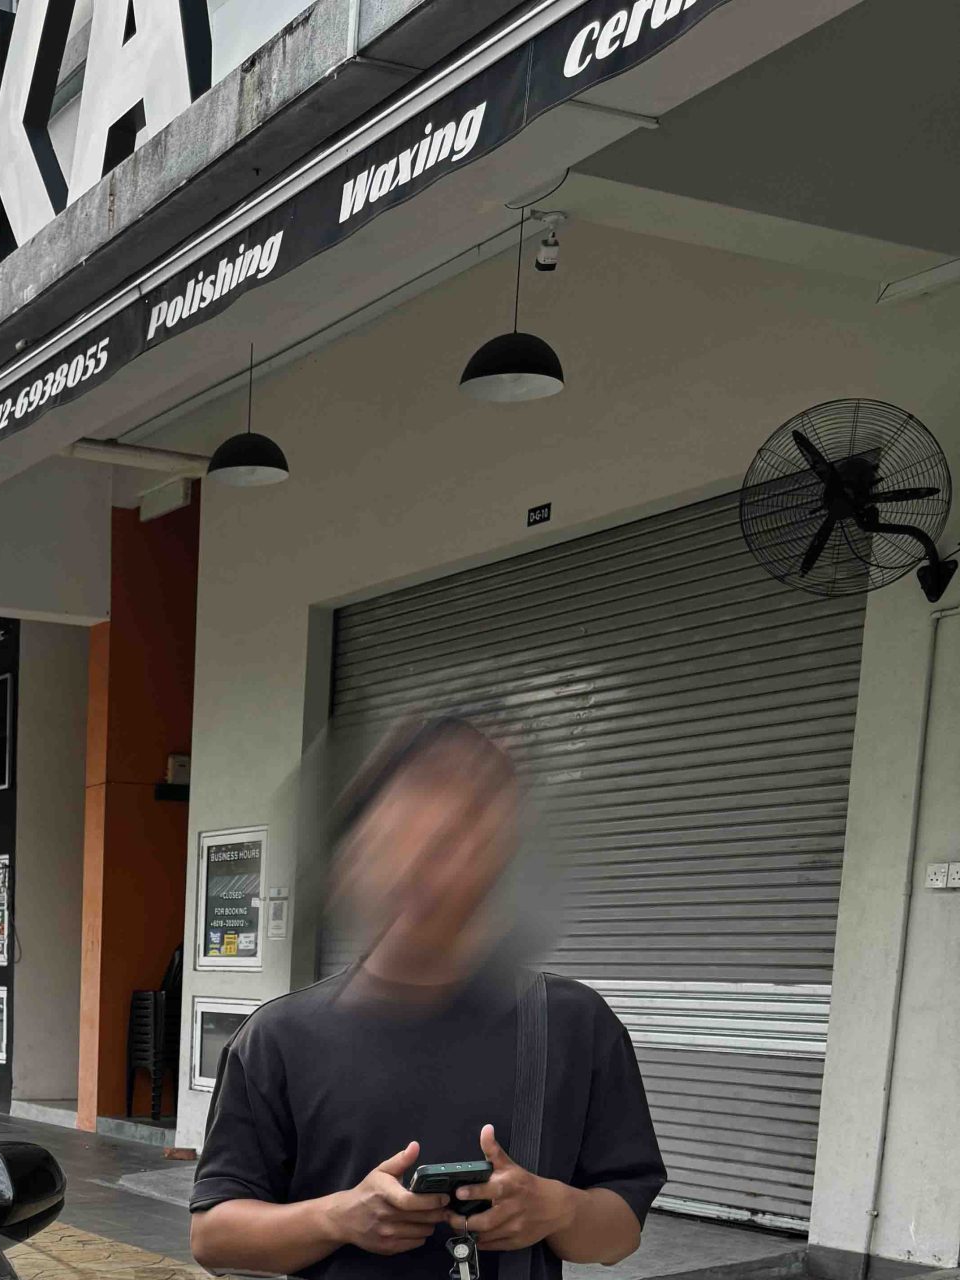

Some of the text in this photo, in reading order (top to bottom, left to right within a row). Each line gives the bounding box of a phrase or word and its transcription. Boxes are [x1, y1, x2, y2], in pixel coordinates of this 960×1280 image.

[563, 0, 697, 78] Cera
[338, 101, 487, 224] Waxing
[146, 230, 284, 341] Polishing
[210, 849, 260, 862] BUSINESS HOURS
[214, 907, 248, 915] FOR BOOKING
